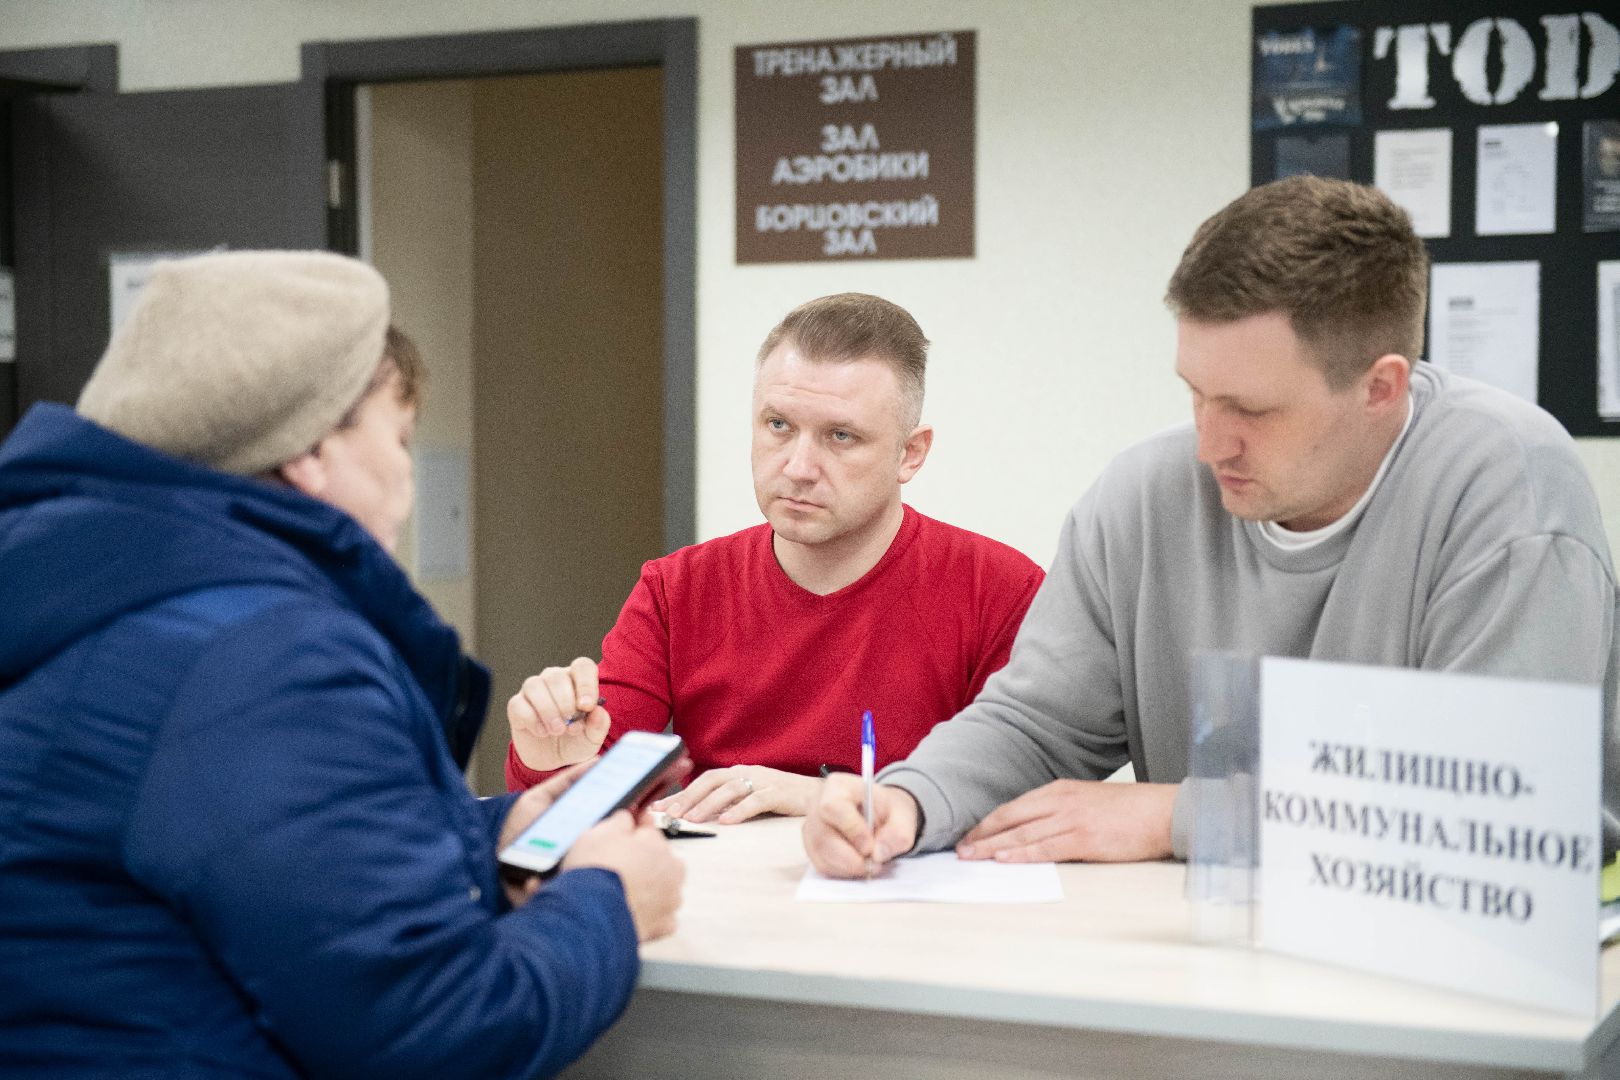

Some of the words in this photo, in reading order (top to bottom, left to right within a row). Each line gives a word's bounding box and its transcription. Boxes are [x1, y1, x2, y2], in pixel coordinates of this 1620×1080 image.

[820, 75, 878, 104] ЗАЛ
[821, 123, 880, 152] ЗАЛ
[772, 152, 929, 184] АЭРОБИКИ
[755, 194, 939, 232] БОРЦОВСКИЙ
[823, 229, 877, 255] ЗАЛ
[1309, 740, 1534, 798] ЖИЛИЩНО-
[1264, 790, 1593, 872] КОММУНАЛЬНОЕ
[1310, 853, 1533, 923] ХОЗЯЙСТВО
